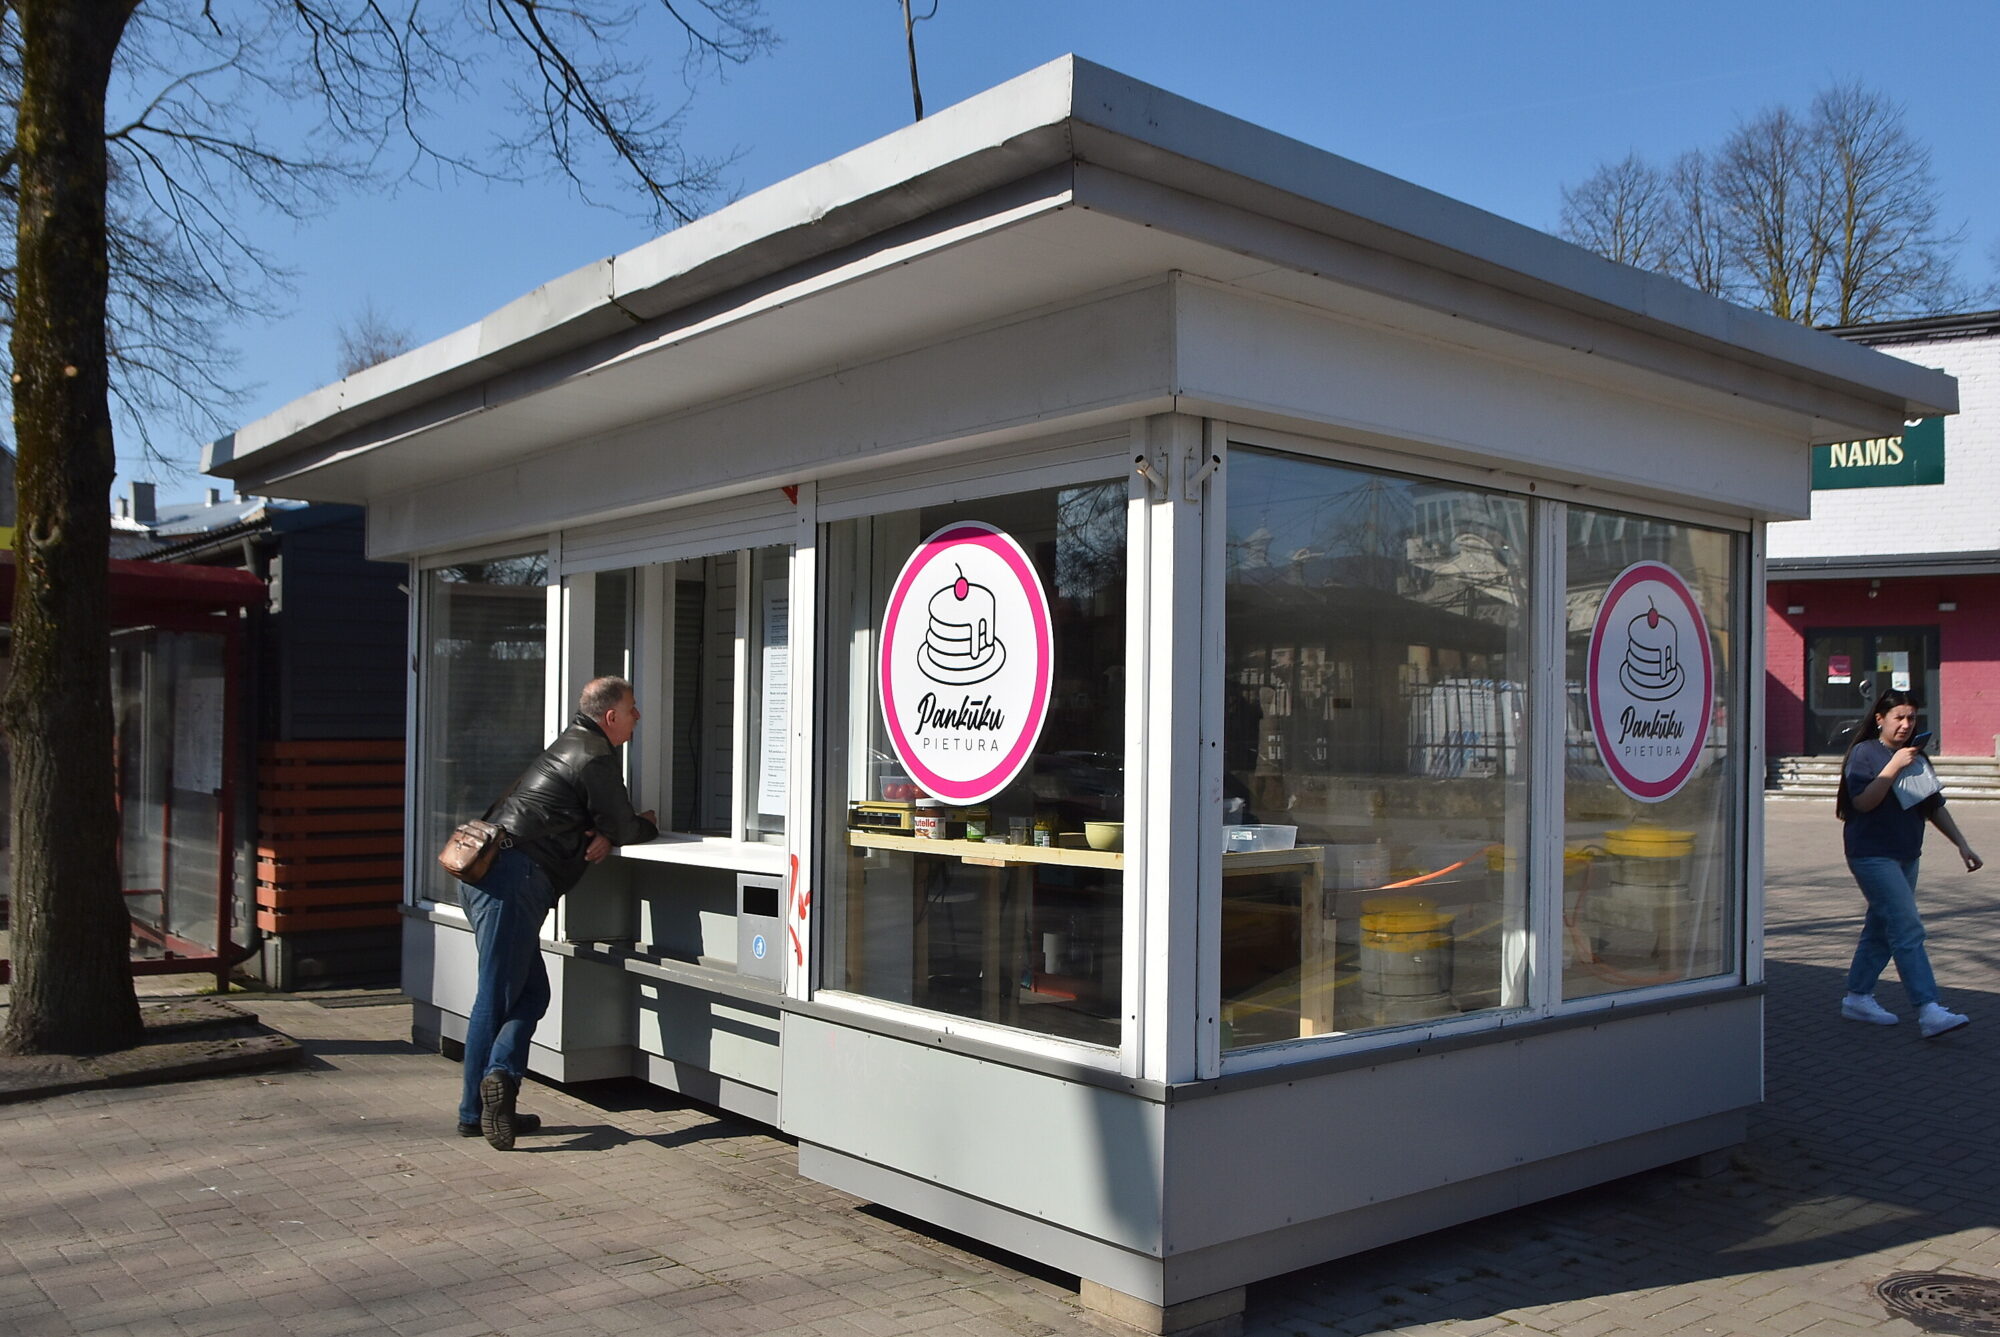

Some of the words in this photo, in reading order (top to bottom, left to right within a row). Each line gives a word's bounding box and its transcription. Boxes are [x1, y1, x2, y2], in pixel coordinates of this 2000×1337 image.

[1830, 436, 1904, 468] NAMS
[915, 692, 1005, 735] Pankūku
[1618, 705, 1685, 744] Pankūku
[923, 738, 999, 752] PIETURA
[1625, 746, 1682, 757] PIETURA
[914, 818, 936, 828] utella
